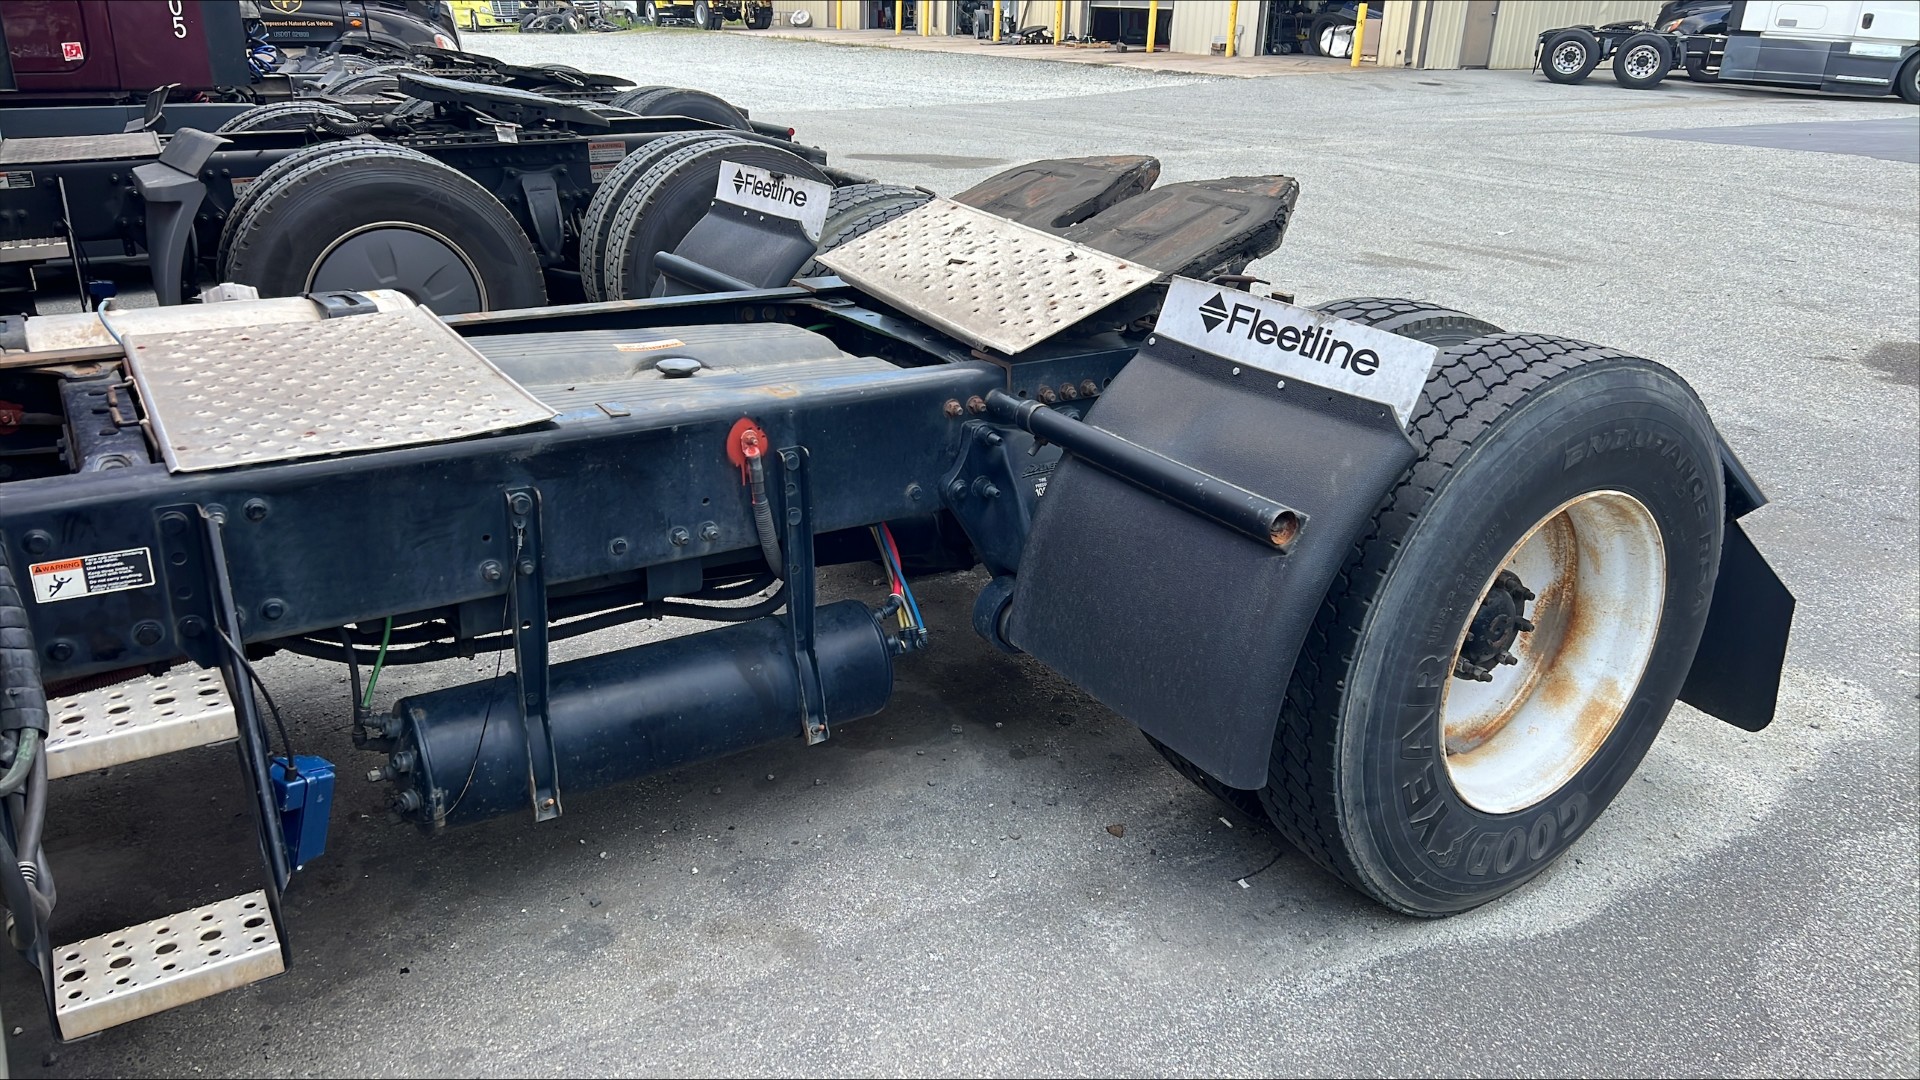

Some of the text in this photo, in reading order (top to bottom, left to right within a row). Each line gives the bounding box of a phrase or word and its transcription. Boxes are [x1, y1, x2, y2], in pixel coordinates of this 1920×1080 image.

[744, 173, 807, 207] Fleetline
[1226, 302, 1380, 376] Fleetline
[1562, 427, 1709, 520] ENDURANCE
[42, 561, 80, 572] WARNING
[1400, 654, 1589, 877] GOODYEAR
